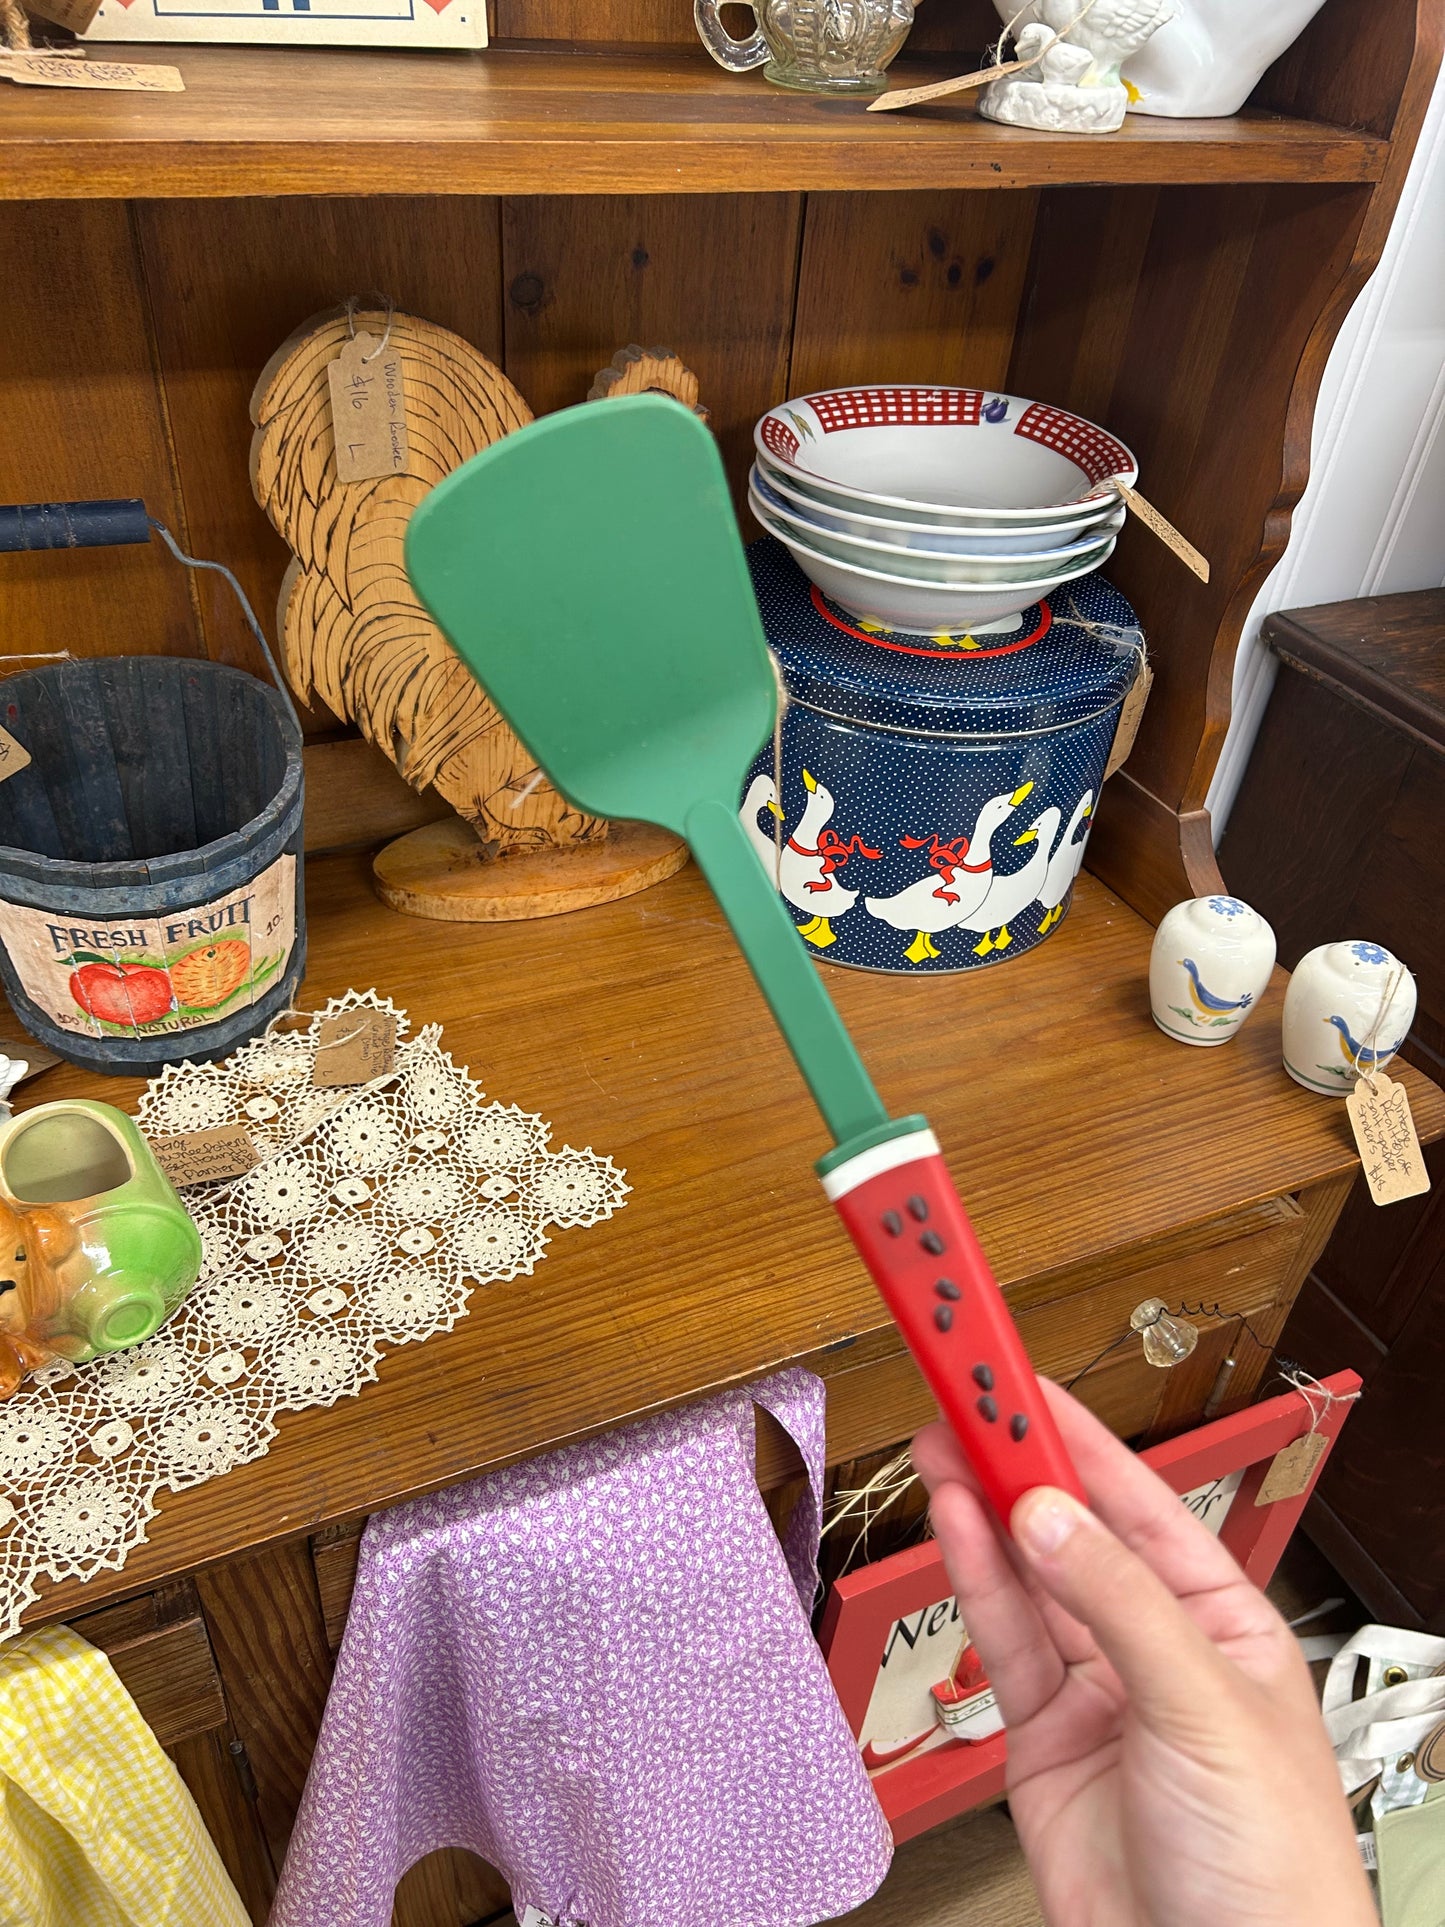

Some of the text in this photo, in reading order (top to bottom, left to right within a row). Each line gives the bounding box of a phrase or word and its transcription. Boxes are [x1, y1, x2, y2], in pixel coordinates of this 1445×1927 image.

[384, 362, 407, 469] Wooden Rooster
[46, 894, 256, 953] FRESH FRUIT
[136, 1014, 215, 1034] NATURAL
[1366, 1097, 1382, 1127] Salt
[881, 1597, 961, 1669] Ne
